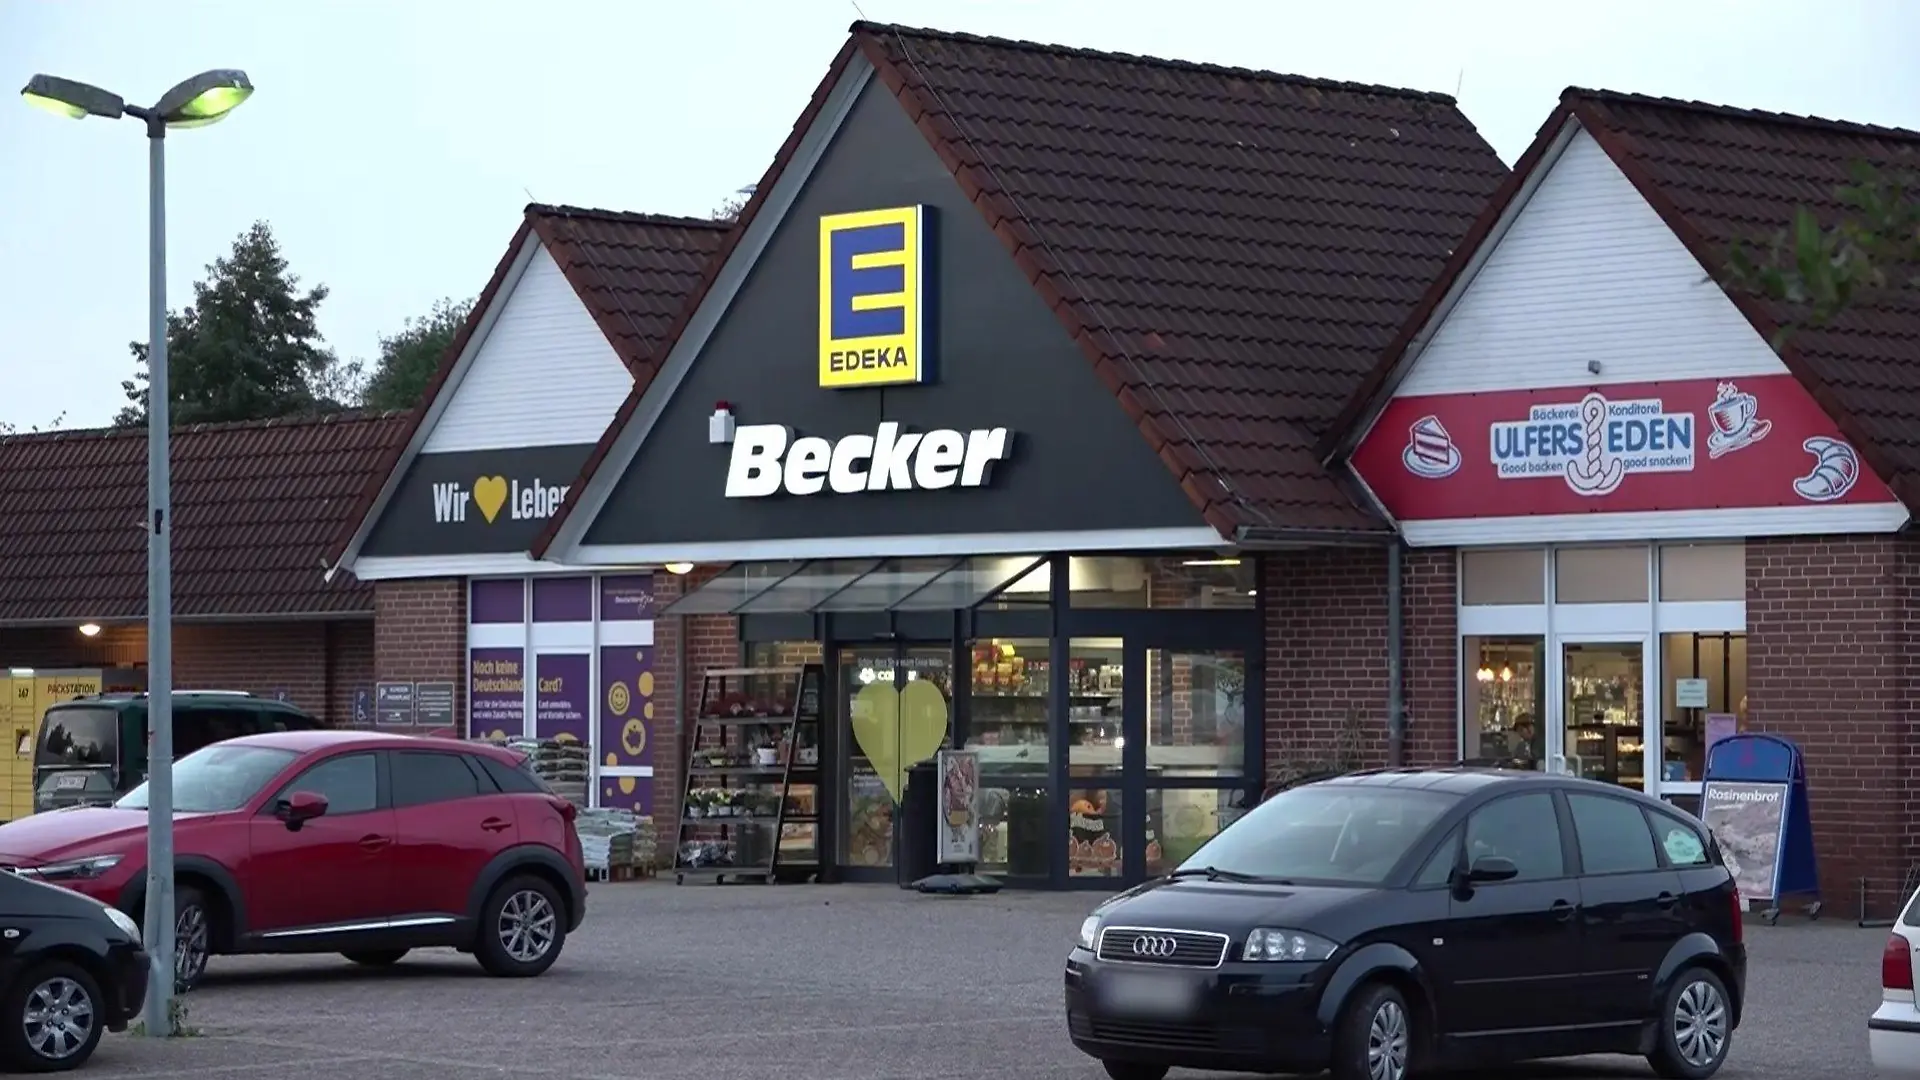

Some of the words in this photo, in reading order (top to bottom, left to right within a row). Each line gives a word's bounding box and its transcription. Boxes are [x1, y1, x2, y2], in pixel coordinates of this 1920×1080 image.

[830, 347, 908, 372] EDEKA
[1533, 407, 1579, 420] Bäckerei
[1609, 403, 1660, 416] Konditorei
[1494, 423, 1583, 459] ULFERS
[1608, 417, 1691, 453] EDEN
[725, 421, 1008, 498] Becker
[1501, 462, 1526, 473] Good
[1528, 461, 1563, 472] backen
[1623, 458, 1647, 470] good
[433, 482, 469, 522] Wir
[473, 660, 494, 674] Noch
[496, 660, 518, 674] keine
[47, 683, 96, 695] PACKSTATION
[473, 678, 525, 693] Deutschland
[538, 678, 563, 692] Card?
[1708, 787, 1780, 802] Rosinenbrot
